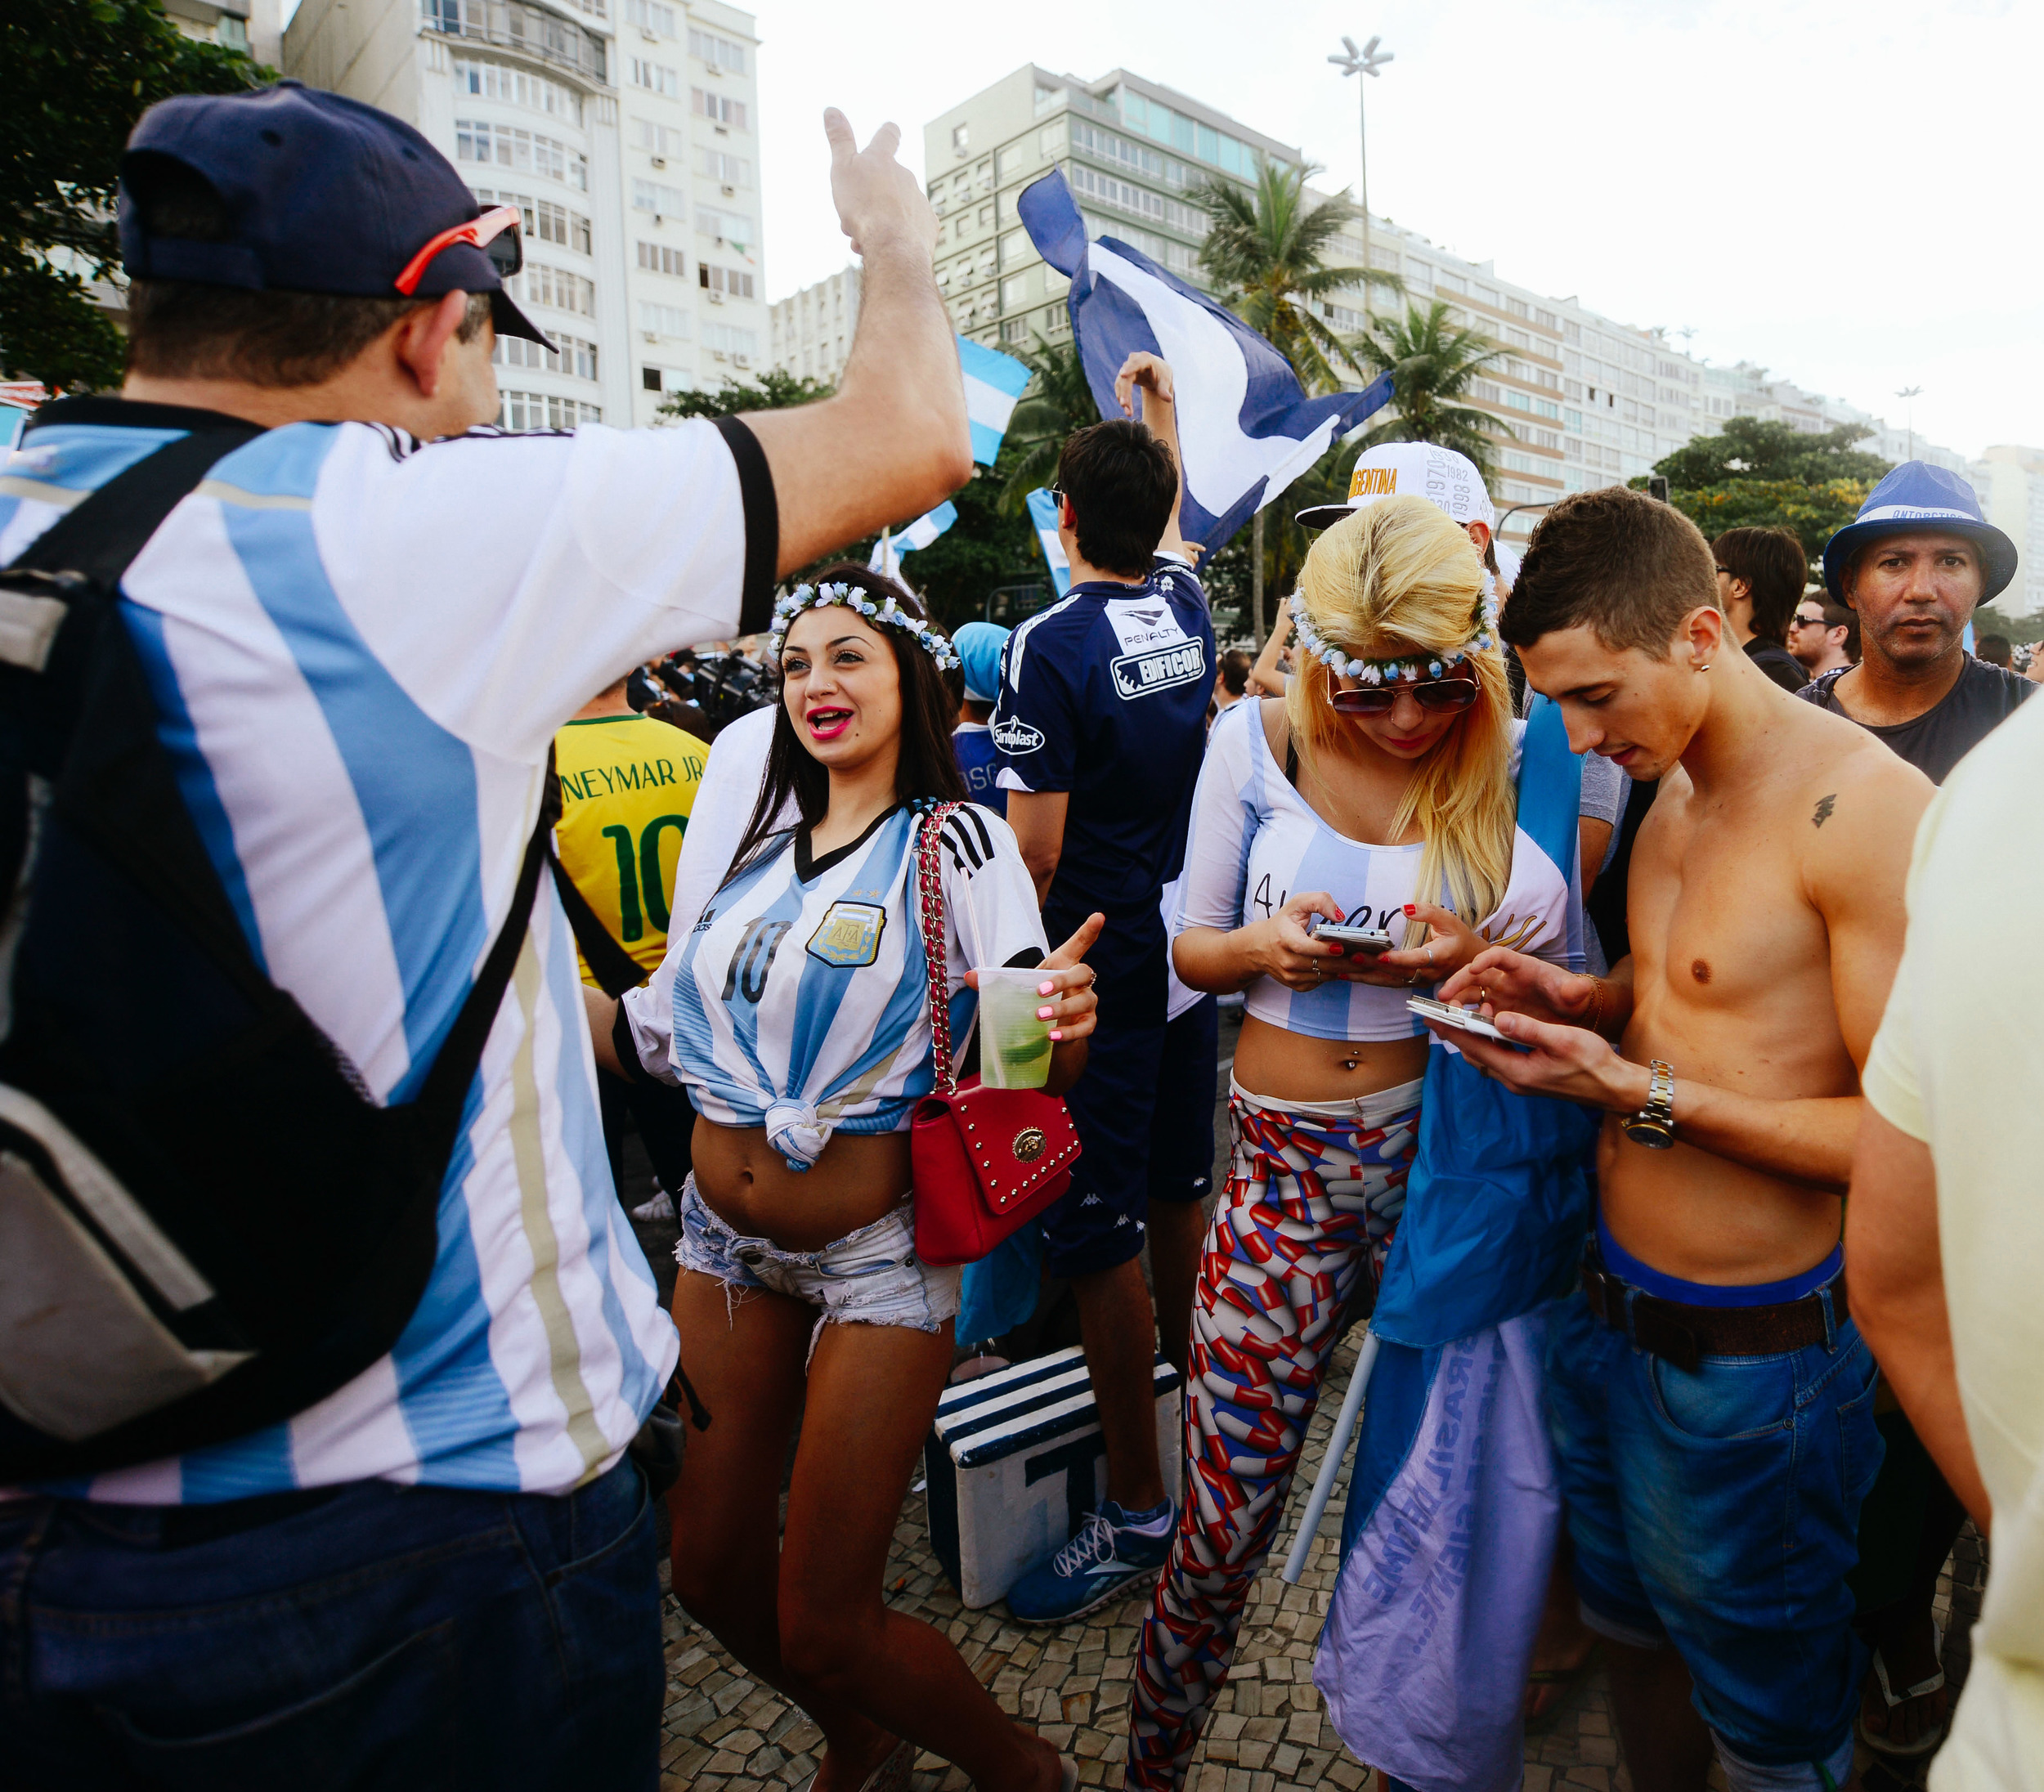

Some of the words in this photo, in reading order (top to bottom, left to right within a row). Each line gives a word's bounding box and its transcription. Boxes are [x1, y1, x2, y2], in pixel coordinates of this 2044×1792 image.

[1348, 468, 1397, 499] GENTINA
[1426, 459, 1446, 496] 1970
[1447, 464, 1468, 482] 1982
[1453, 484, 1470, 516] 1998
[1123, 627, 1179, 647] PENALTY
[1138, 647, 1200, 684] EDIFICOR
[995, 728, 1038, 747] Sintplast
[560, 759, 677, 803] NEYMAR
[682, 755, 704, 782] JR
[602, 814, 690, 943] 10
[832, 925, 858, 945] AFA
[721, 916, 793, 1004] 10
